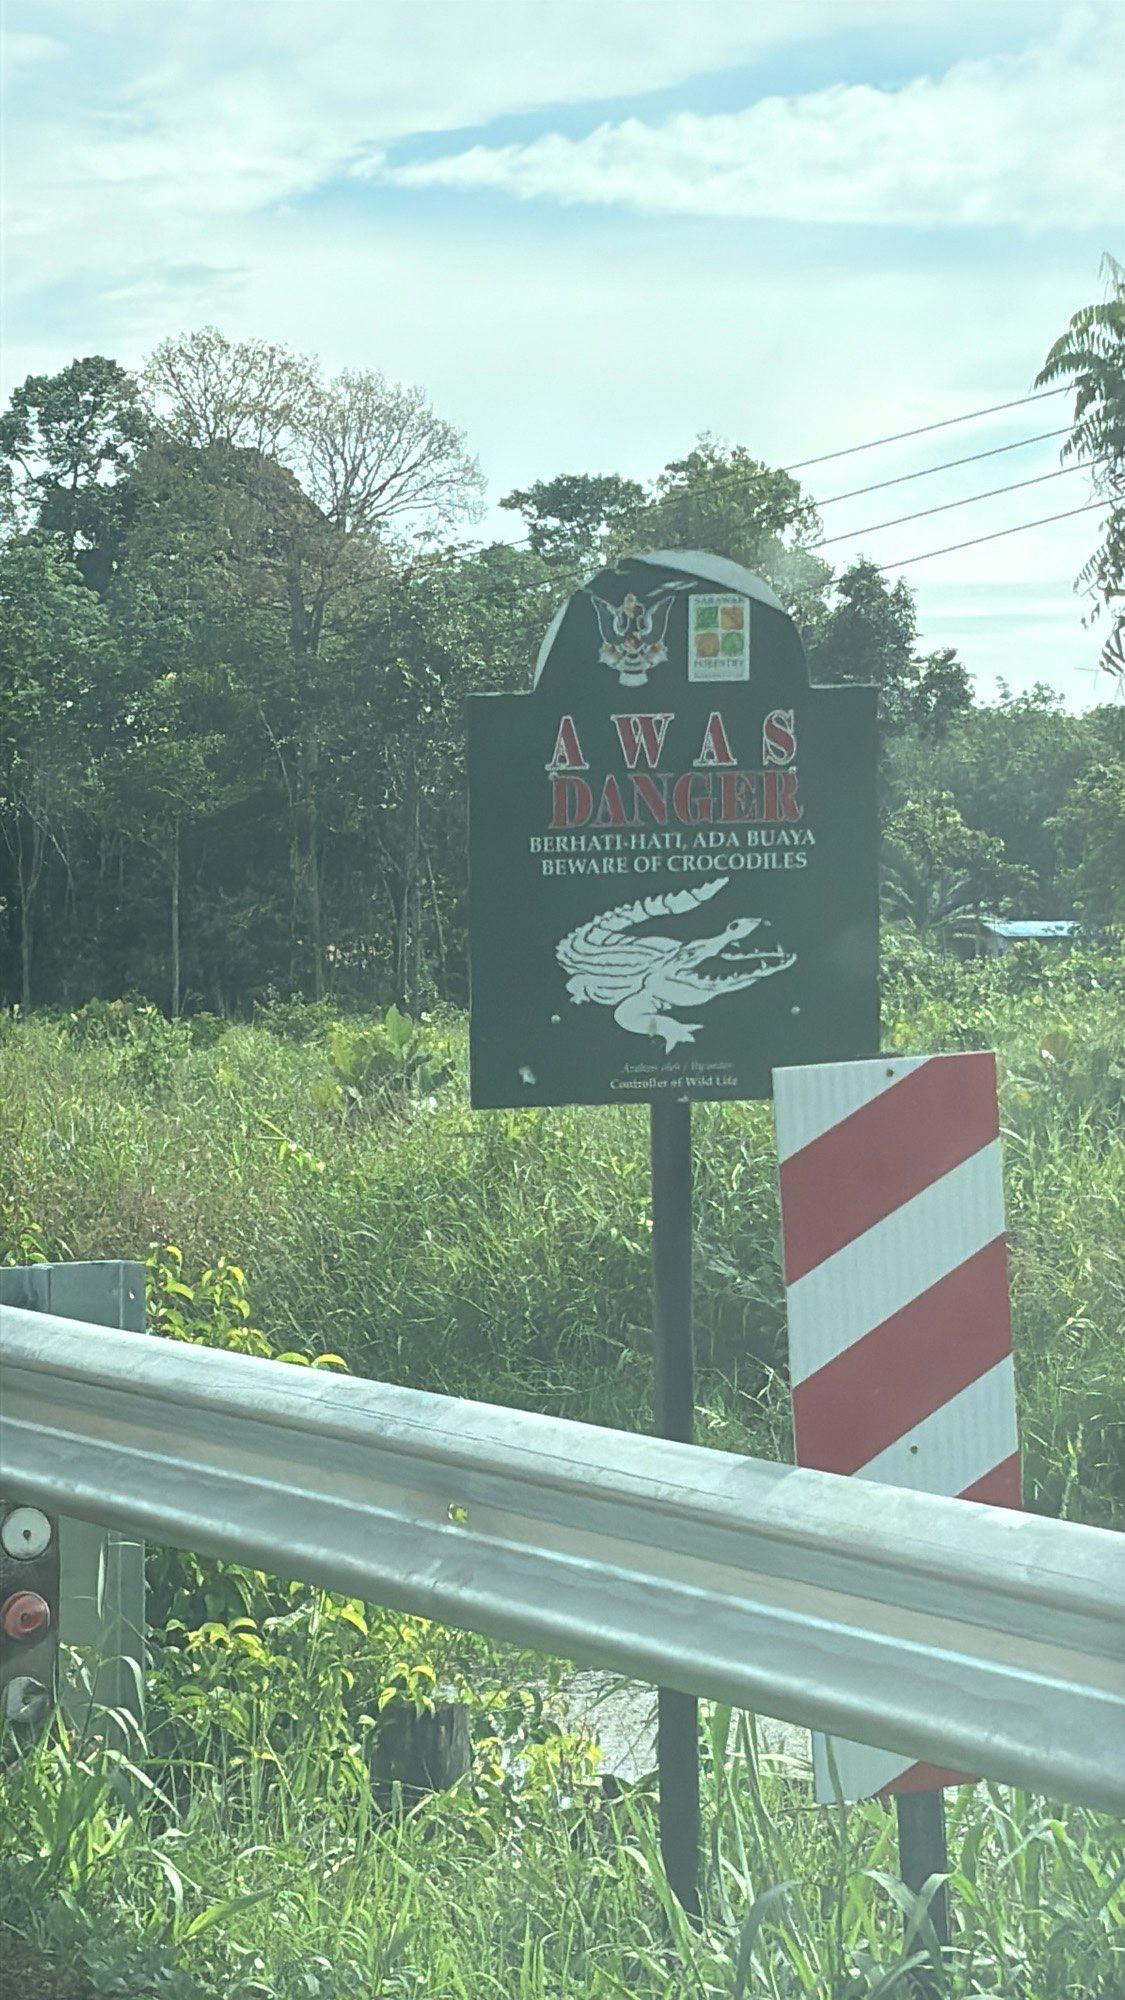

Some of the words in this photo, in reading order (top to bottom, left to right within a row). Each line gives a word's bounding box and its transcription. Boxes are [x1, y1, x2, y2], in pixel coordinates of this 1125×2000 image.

[545, 709, 797, 771] AWAS
[548, 770, 804, 829] DANGER
[529, 832, 687, 852] BERHATI-HATI,
[692, 832, 740, 848] ADA
[747, 829, 816, 847] BUAYA
[541, 856, 628, 875] BEWARE
[633, 855, 661, 873] OF
[667, 851, 808, 872] CROCODILES
[670, 1077, 682, 1088] of
[686, 1076, 713, 1087] Wild
